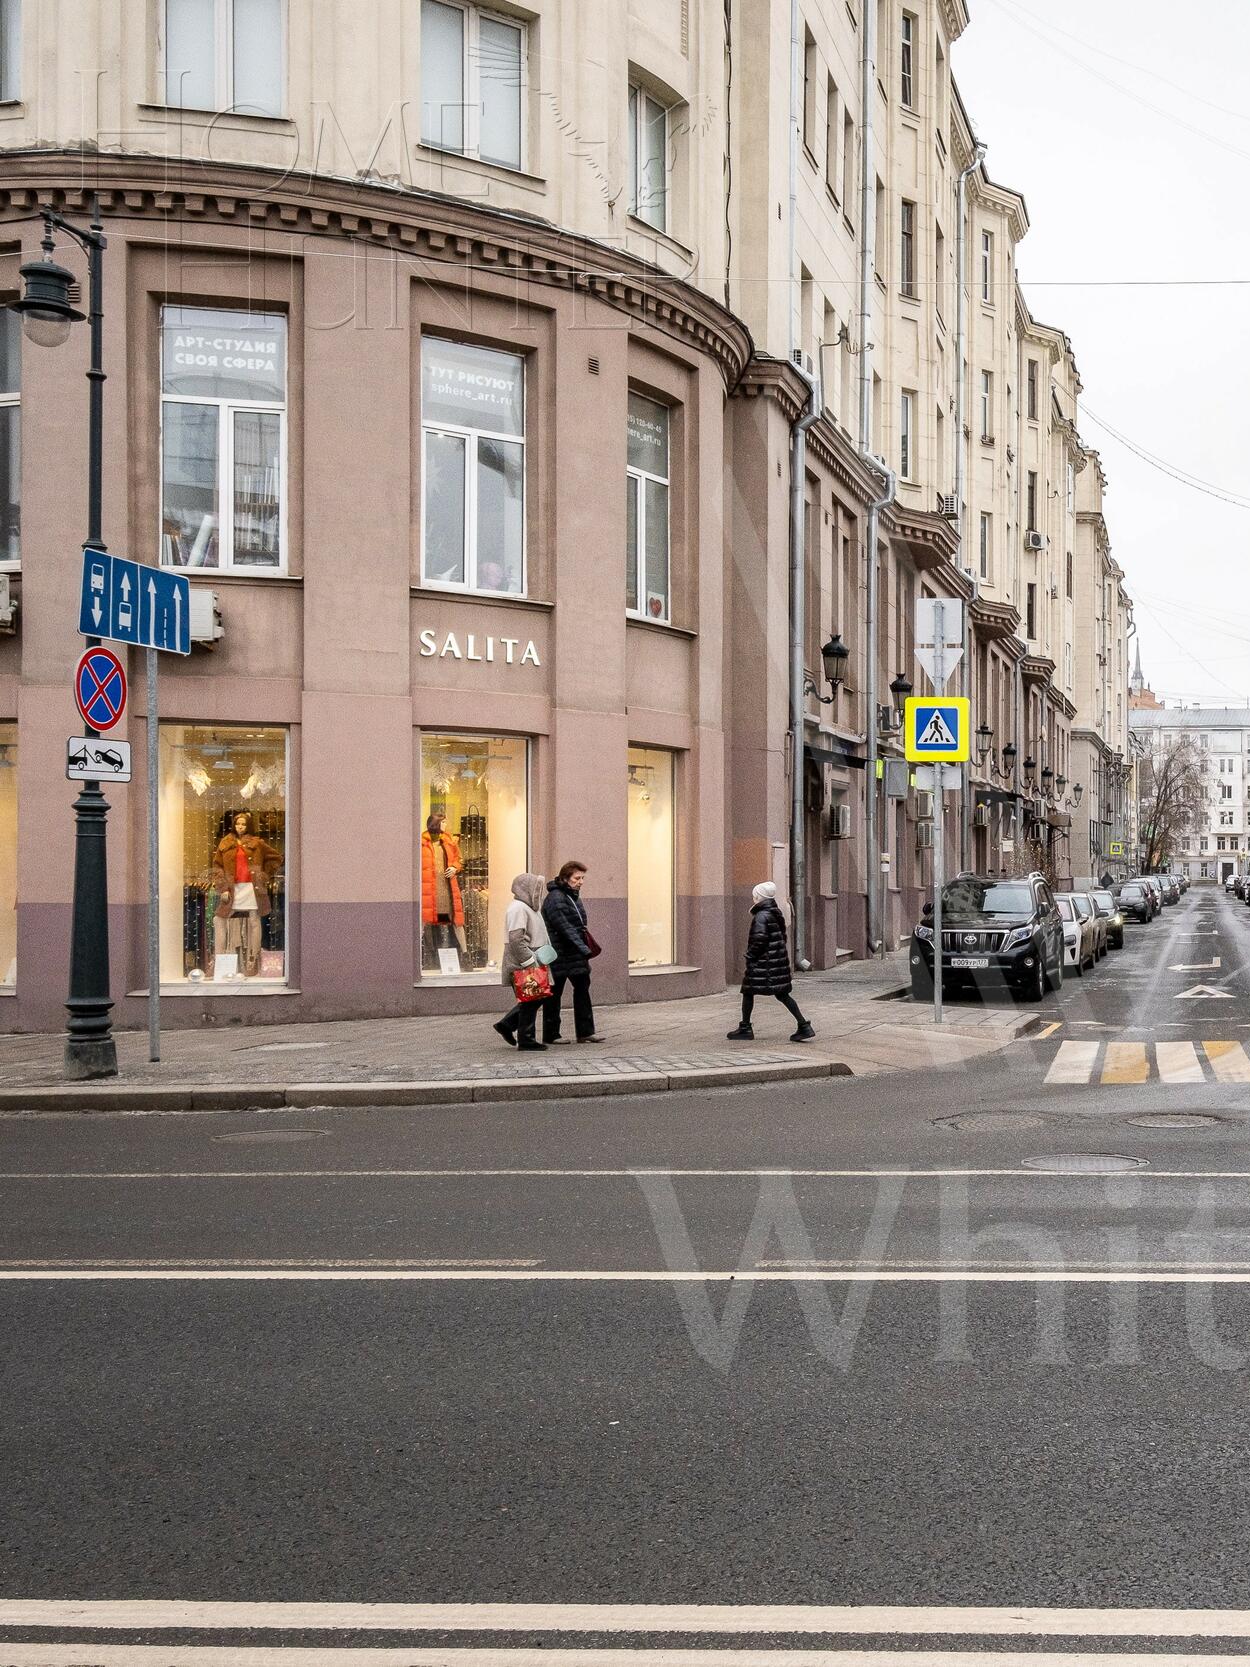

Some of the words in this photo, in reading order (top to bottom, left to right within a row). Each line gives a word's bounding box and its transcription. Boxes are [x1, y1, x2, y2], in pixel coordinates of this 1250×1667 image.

[174, 335, 276, 354] АРТ-СТУДИЯ
[175, 352, 219, 367] СВОЯ
[222, 356, 275, 371] СФЕРА
[430, 366, 454, 380] ТУТ
[458, 371, 514, 391] РИСУЮТ
[431, 383, 512, 406] sphere_art.ru
[419, 629, 541, 666] SALITA
